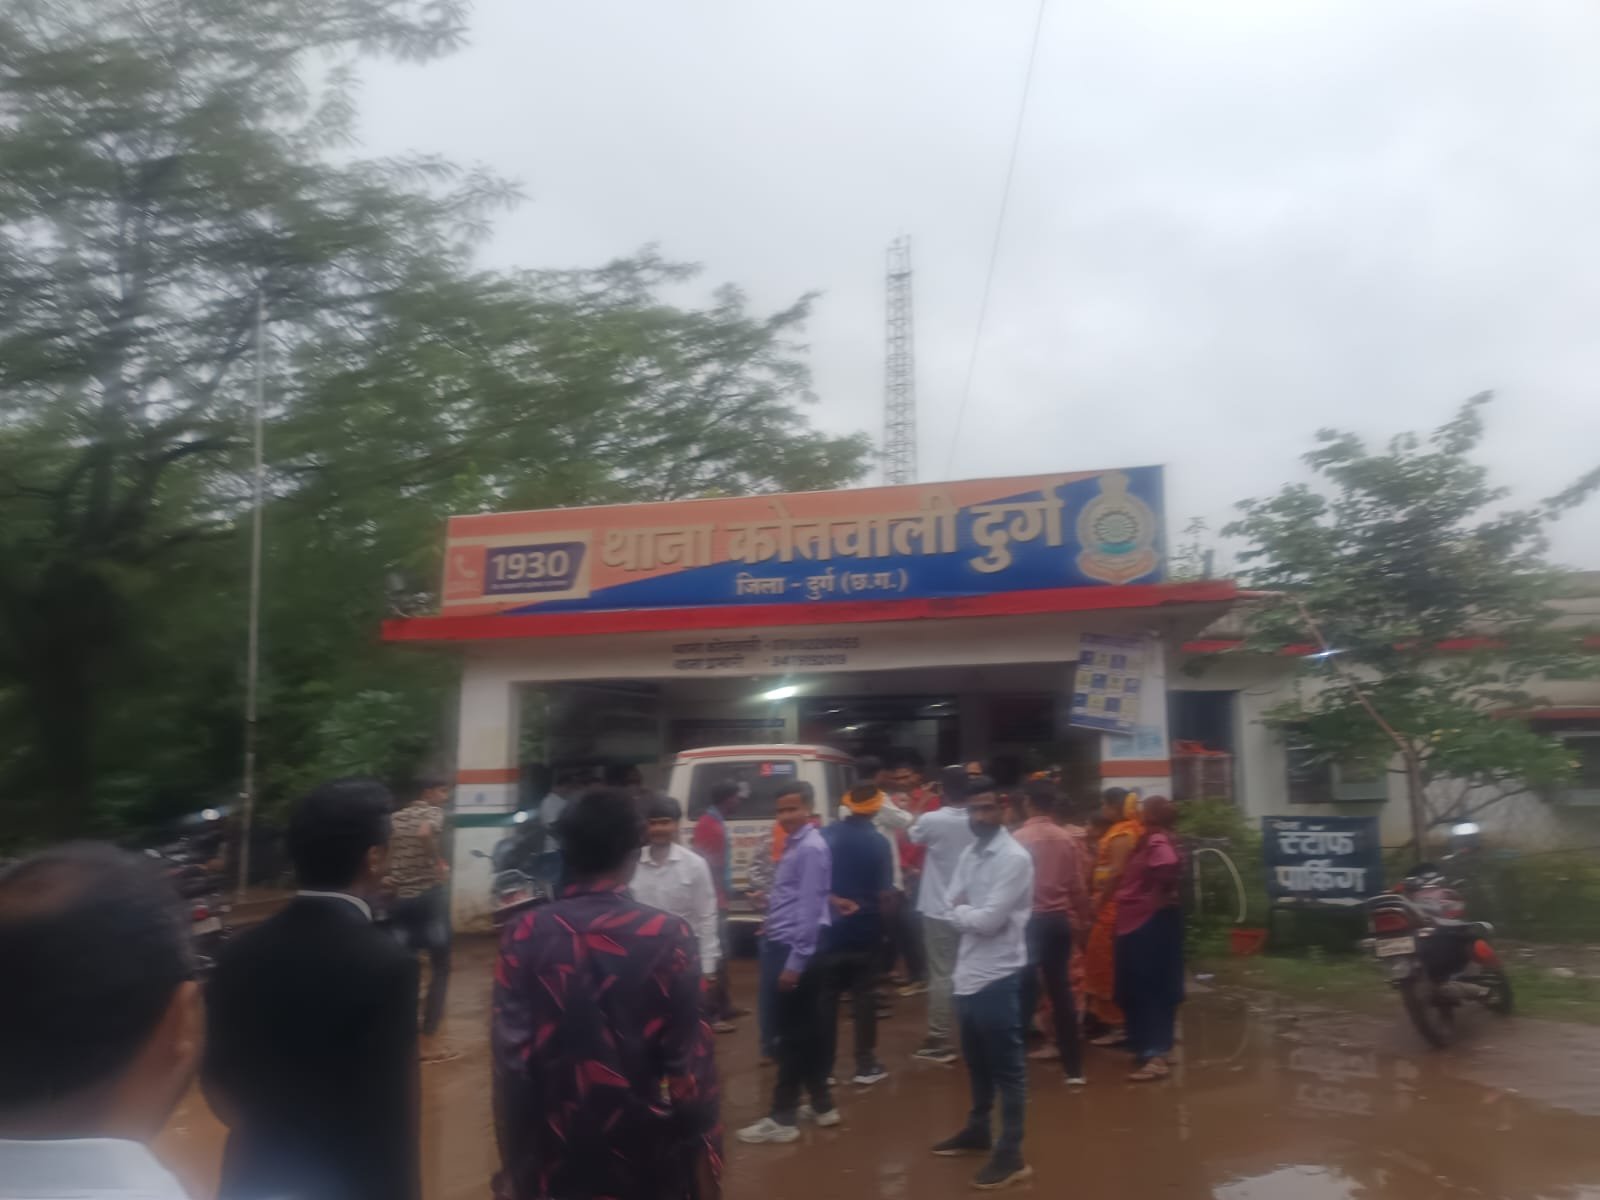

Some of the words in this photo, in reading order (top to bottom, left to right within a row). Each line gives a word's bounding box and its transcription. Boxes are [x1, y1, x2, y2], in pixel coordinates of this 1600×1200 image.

[601, 523, 716, 572] थाना
[725, 495, 959, 566] कोतवाली
[969, 480, 1065, 574] दुर्ग
[491, 550, 569, 580] 1930
[736, 572, 786, 595] जिला
[804, 567, 836, 600] दुर्ग
